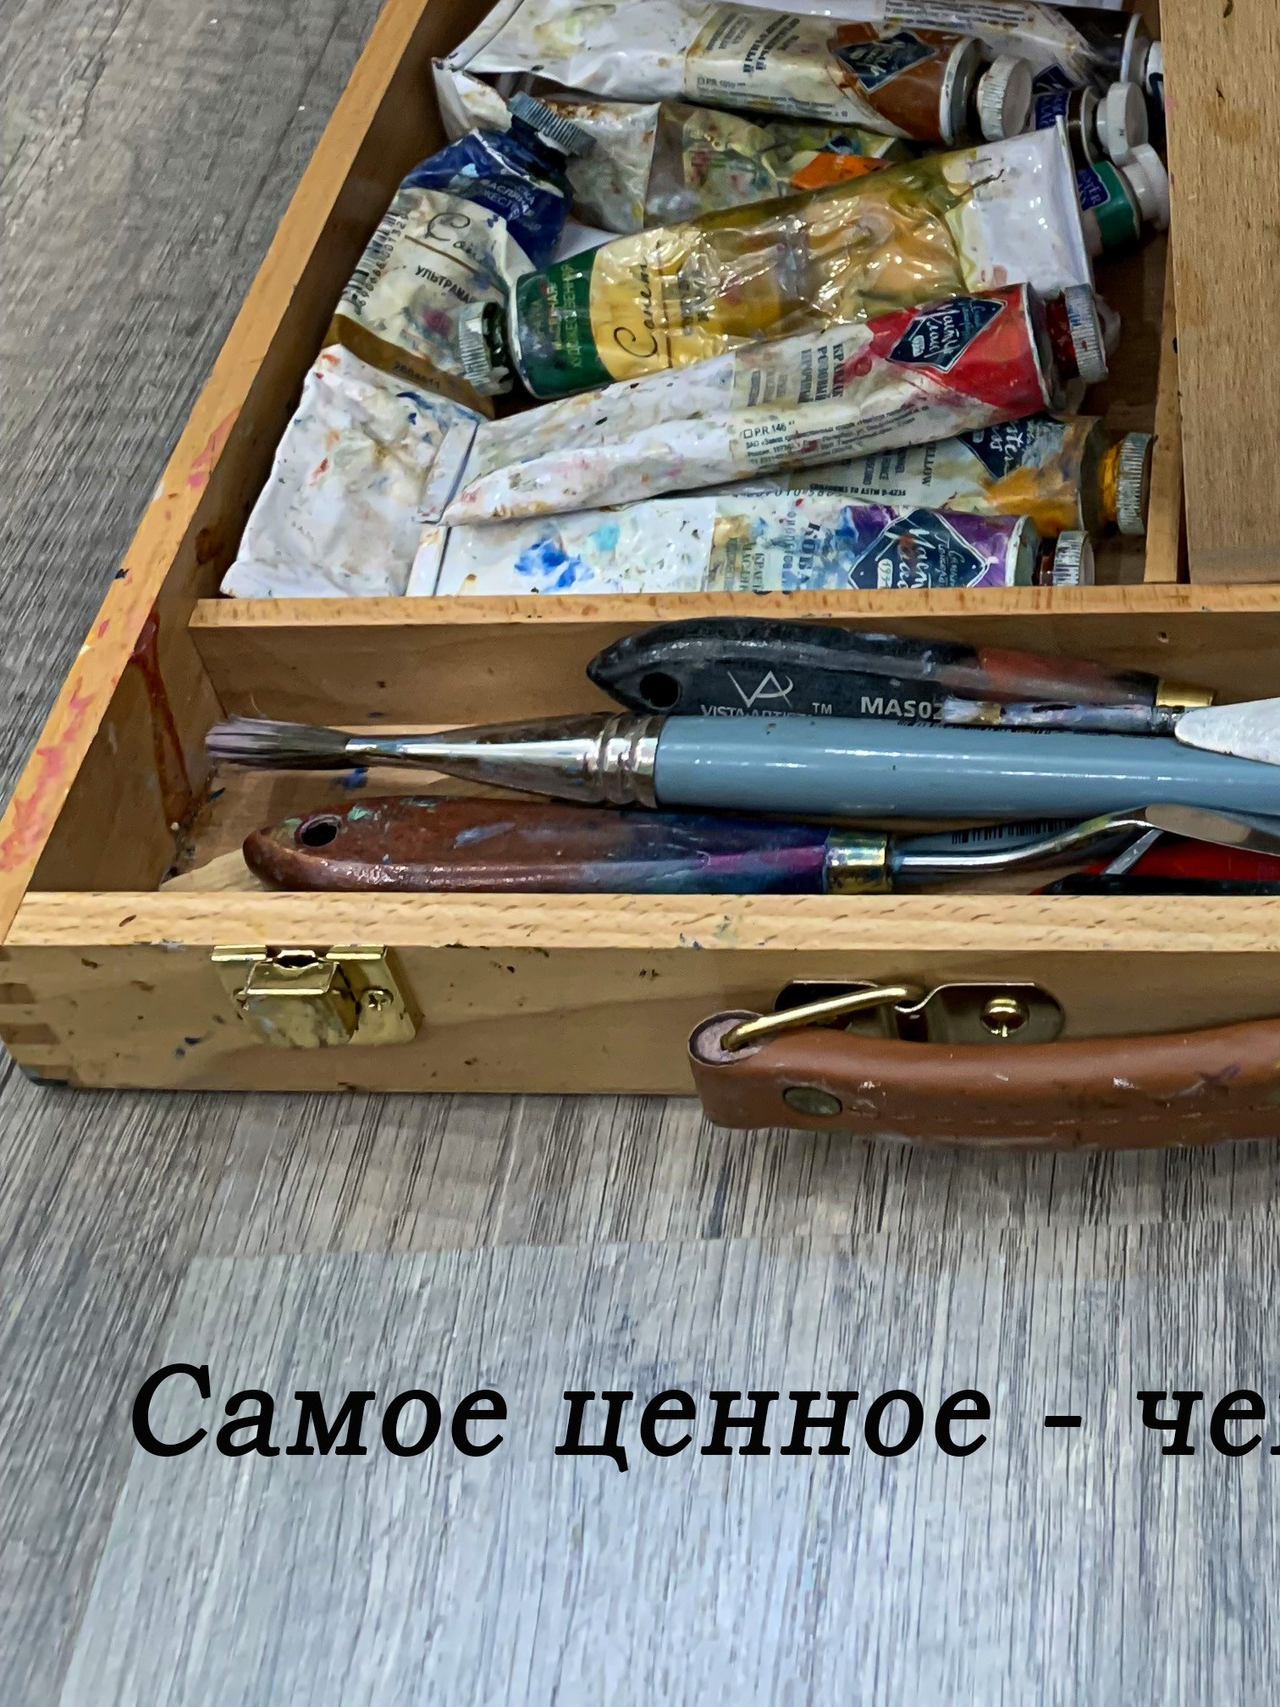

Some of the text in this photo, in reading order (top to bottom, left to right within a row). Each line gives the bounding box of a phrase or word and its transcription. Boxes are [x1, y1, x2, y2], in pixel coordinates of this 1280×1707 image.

[849, 485, 860, 495] TO
[860, 485, 881, 496] ASTM
[908, 527, 936, 589] Маст
